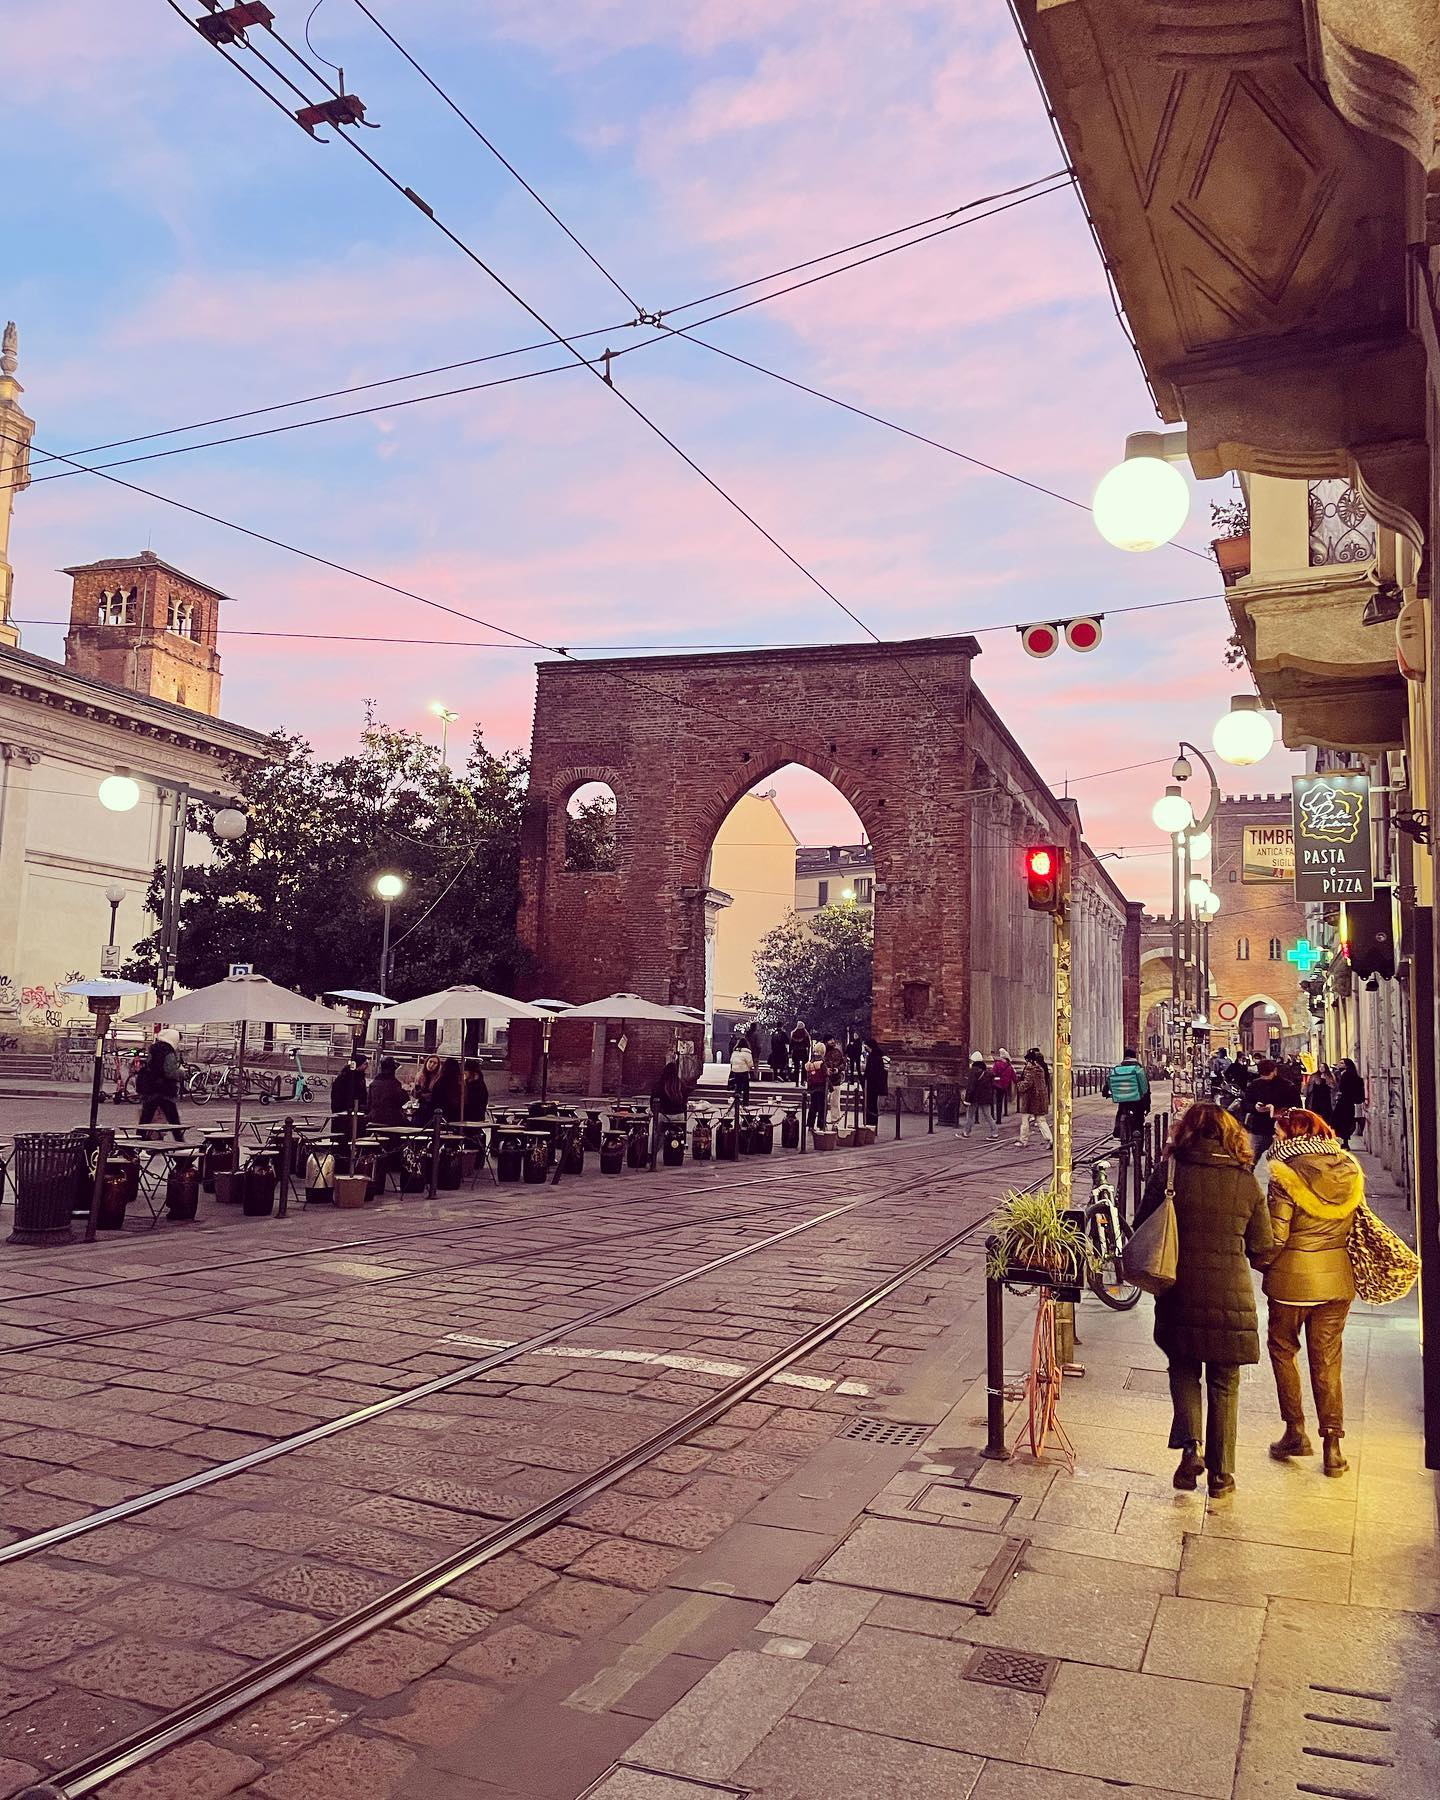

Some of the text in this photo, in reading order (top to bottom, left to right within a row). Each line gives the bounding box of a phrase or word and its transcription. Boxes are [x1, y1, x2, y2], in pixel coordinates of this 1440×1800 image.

[1250, 830, 1294, 844] TIMBR
[1257, 847, 1283, 856] ANTICA
[1304, 849, 1345, 864] PASTA
[1330, 866, 1337, 876] e
[1323, 878, 1362, 893] PIZZA
